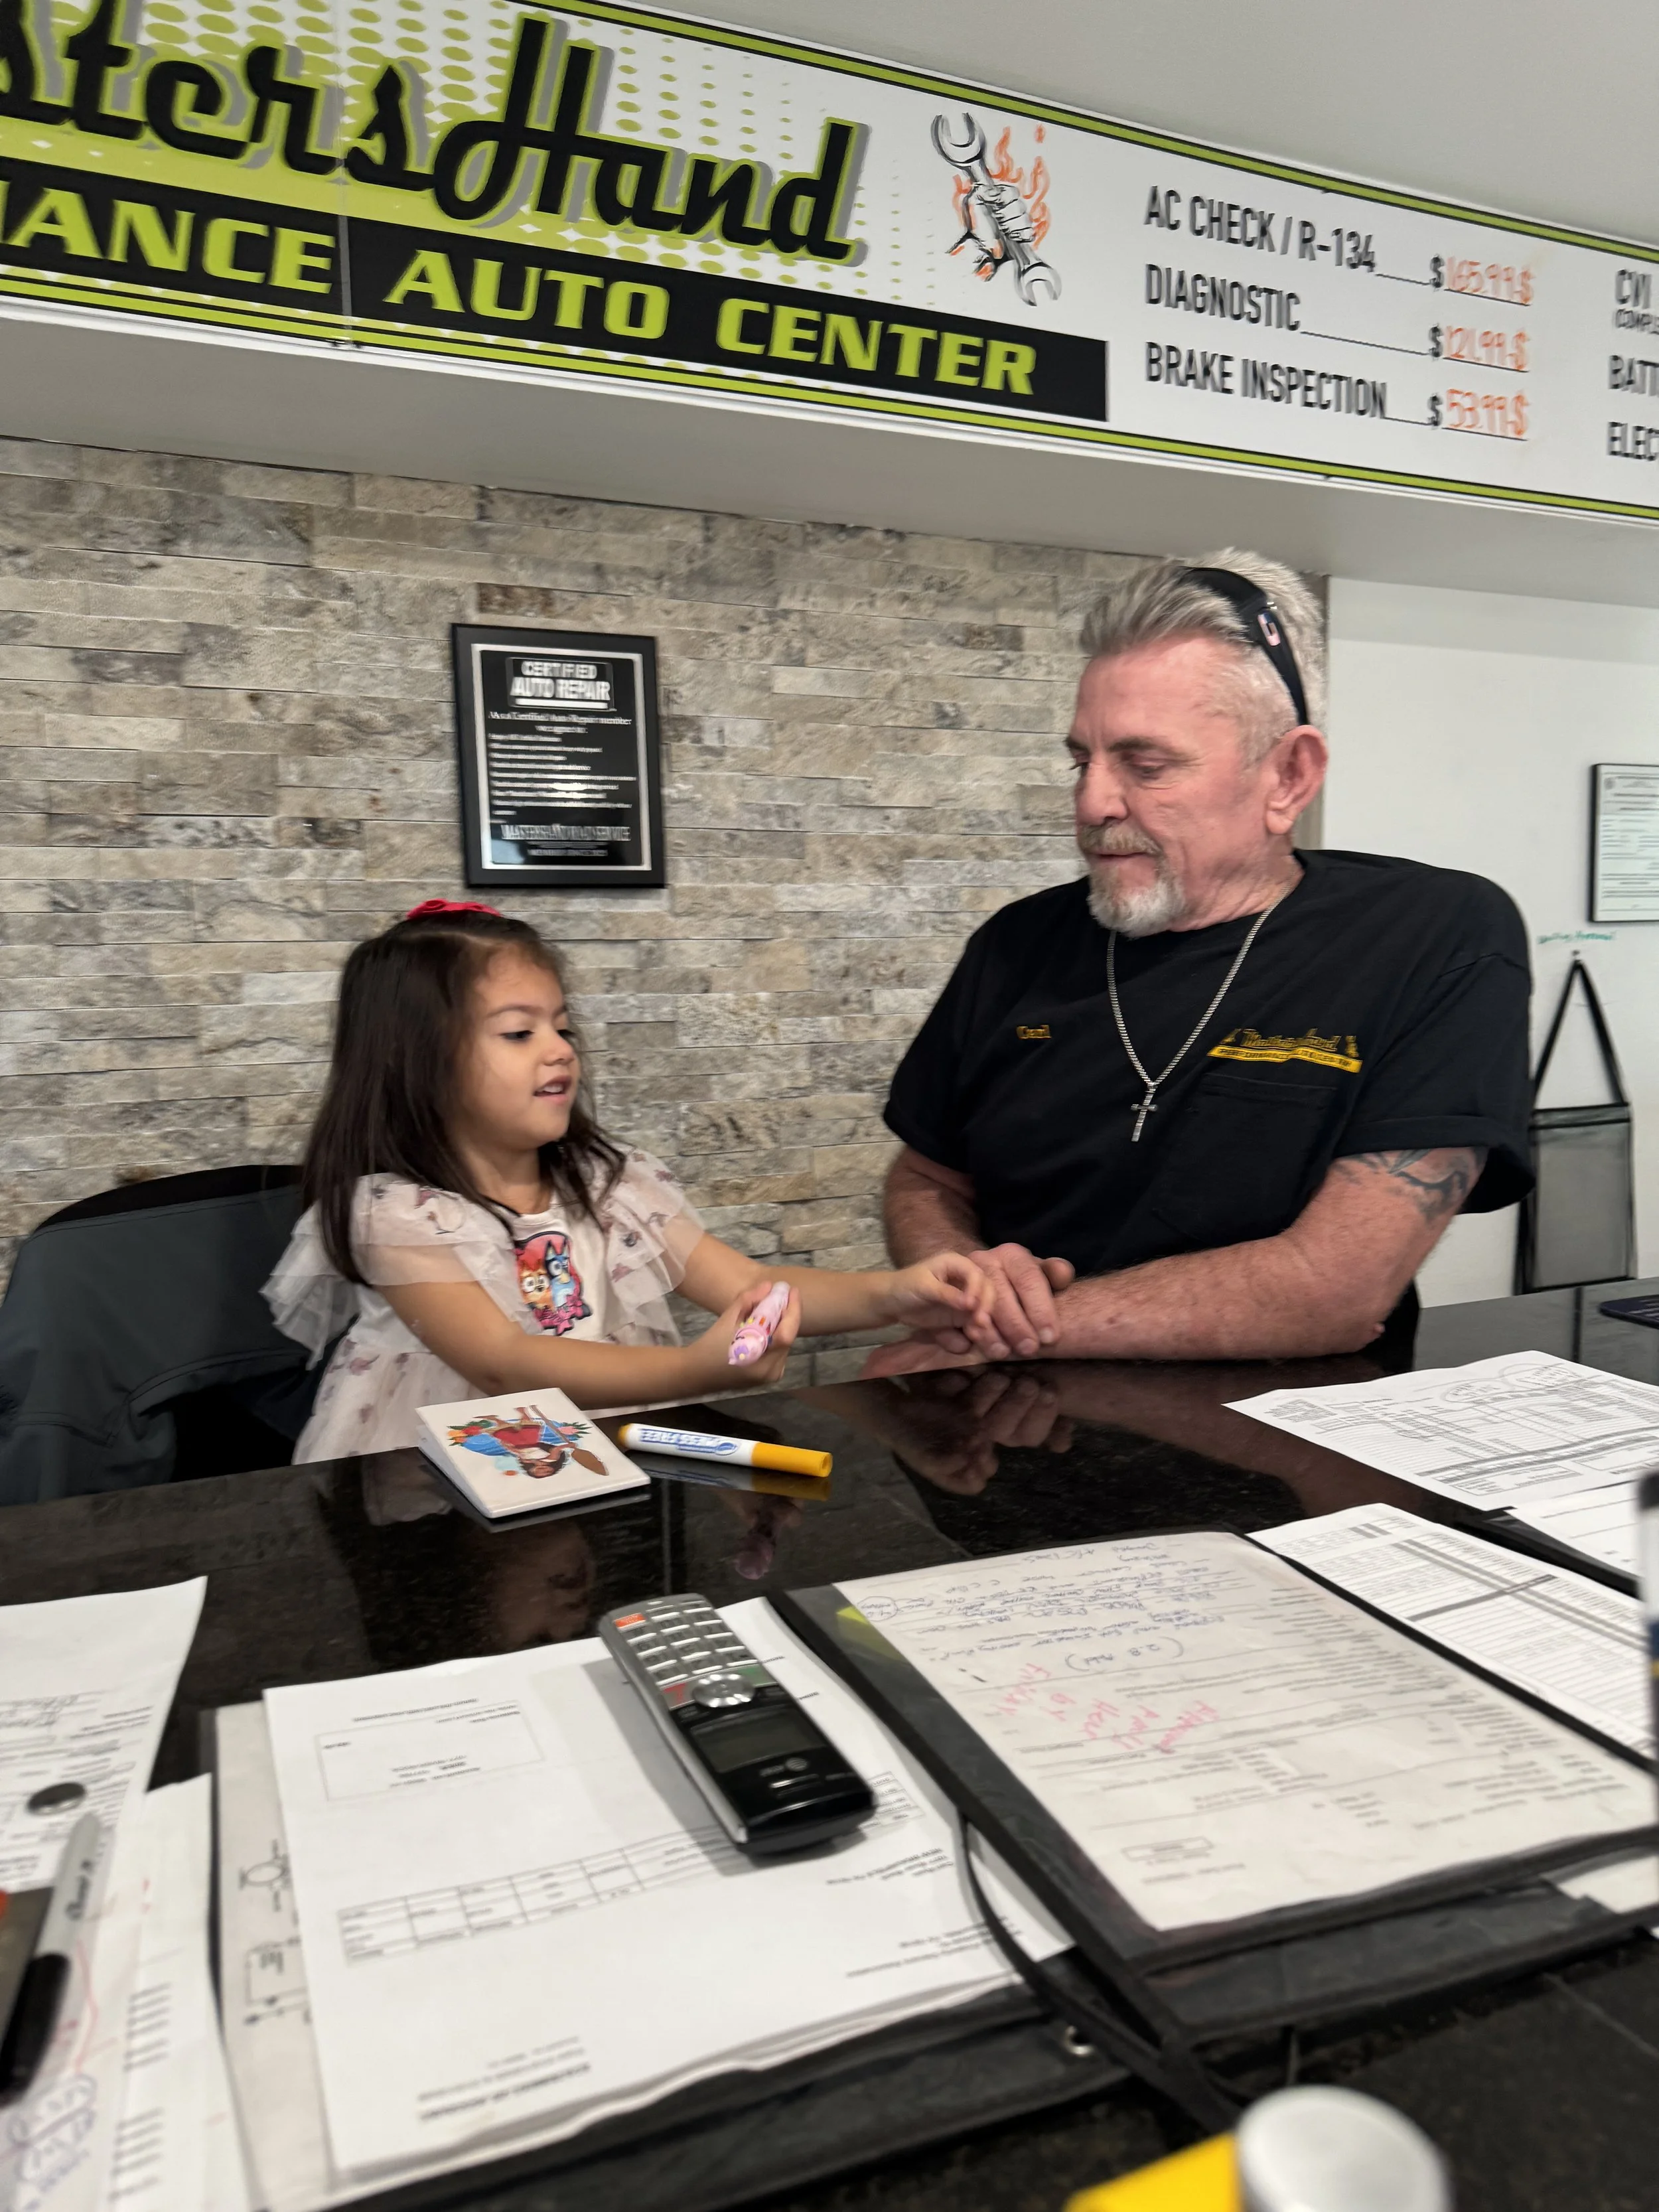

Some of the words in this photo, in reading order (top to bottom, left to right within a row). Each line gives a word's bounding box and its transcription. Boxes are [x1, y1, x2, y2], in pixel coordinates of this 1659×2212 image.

[1143, 185, 1181, 230] AC
[1189, 195, 1275, 252] CHECK
[1279, 216, 1293, 255] /
[1298, 220, 1376, 273] R-134
[383, 249, 671, 340] AUTO
[715, 297, 1037, 396] CENTER
[1145, 263, 1301, 332] DIAGNOSTIC
[1145, 341, 1234, 394] BRAKE
[1241, 358, 1388, 419] INSPECTION
[510, 676, 555, 698] AUTO
[555, 679, 611, 701] REPAIR
